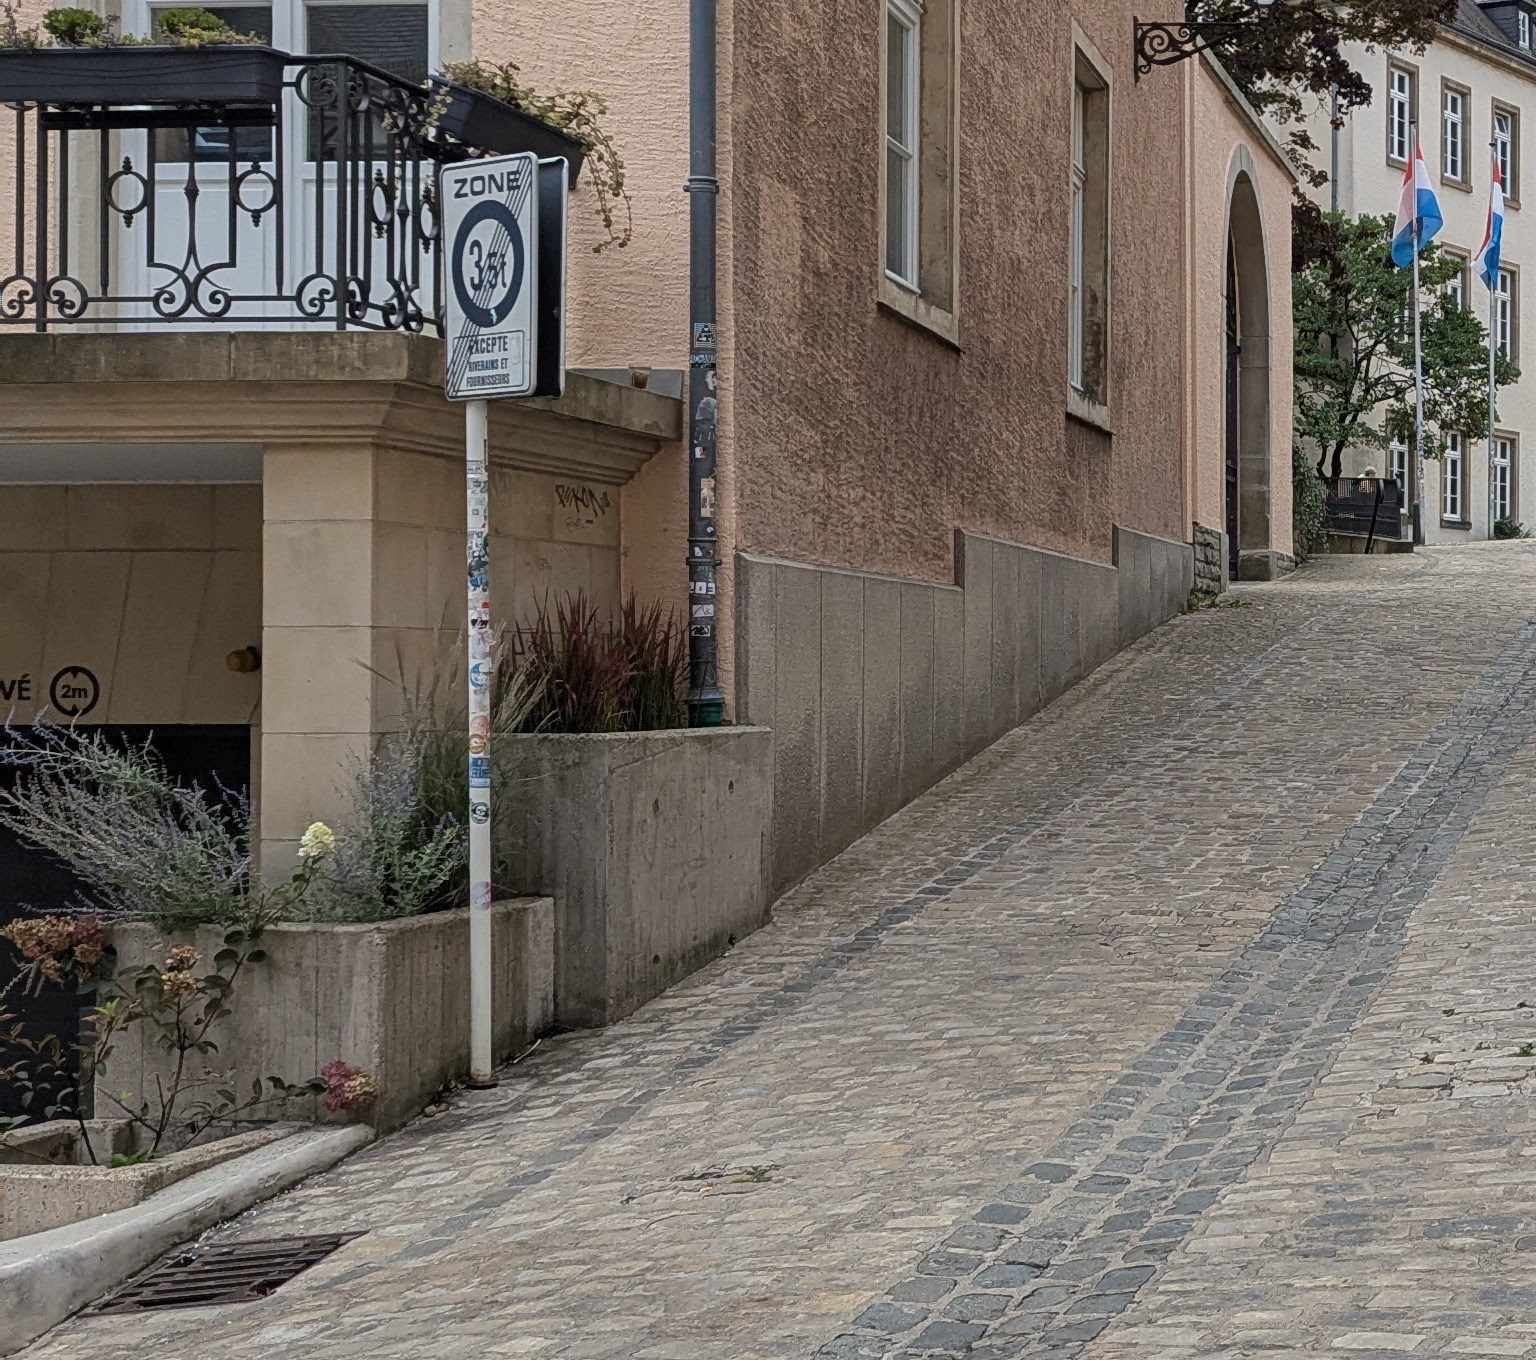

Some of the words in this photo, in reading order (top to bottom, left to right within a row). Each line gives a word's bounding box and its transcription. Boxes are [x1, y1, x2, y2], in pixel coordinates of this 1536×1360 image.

[454, 171, 520, 199] ZONE
[500, 358, 509, 370] ET
[60, 684, 88, 699] 2m
